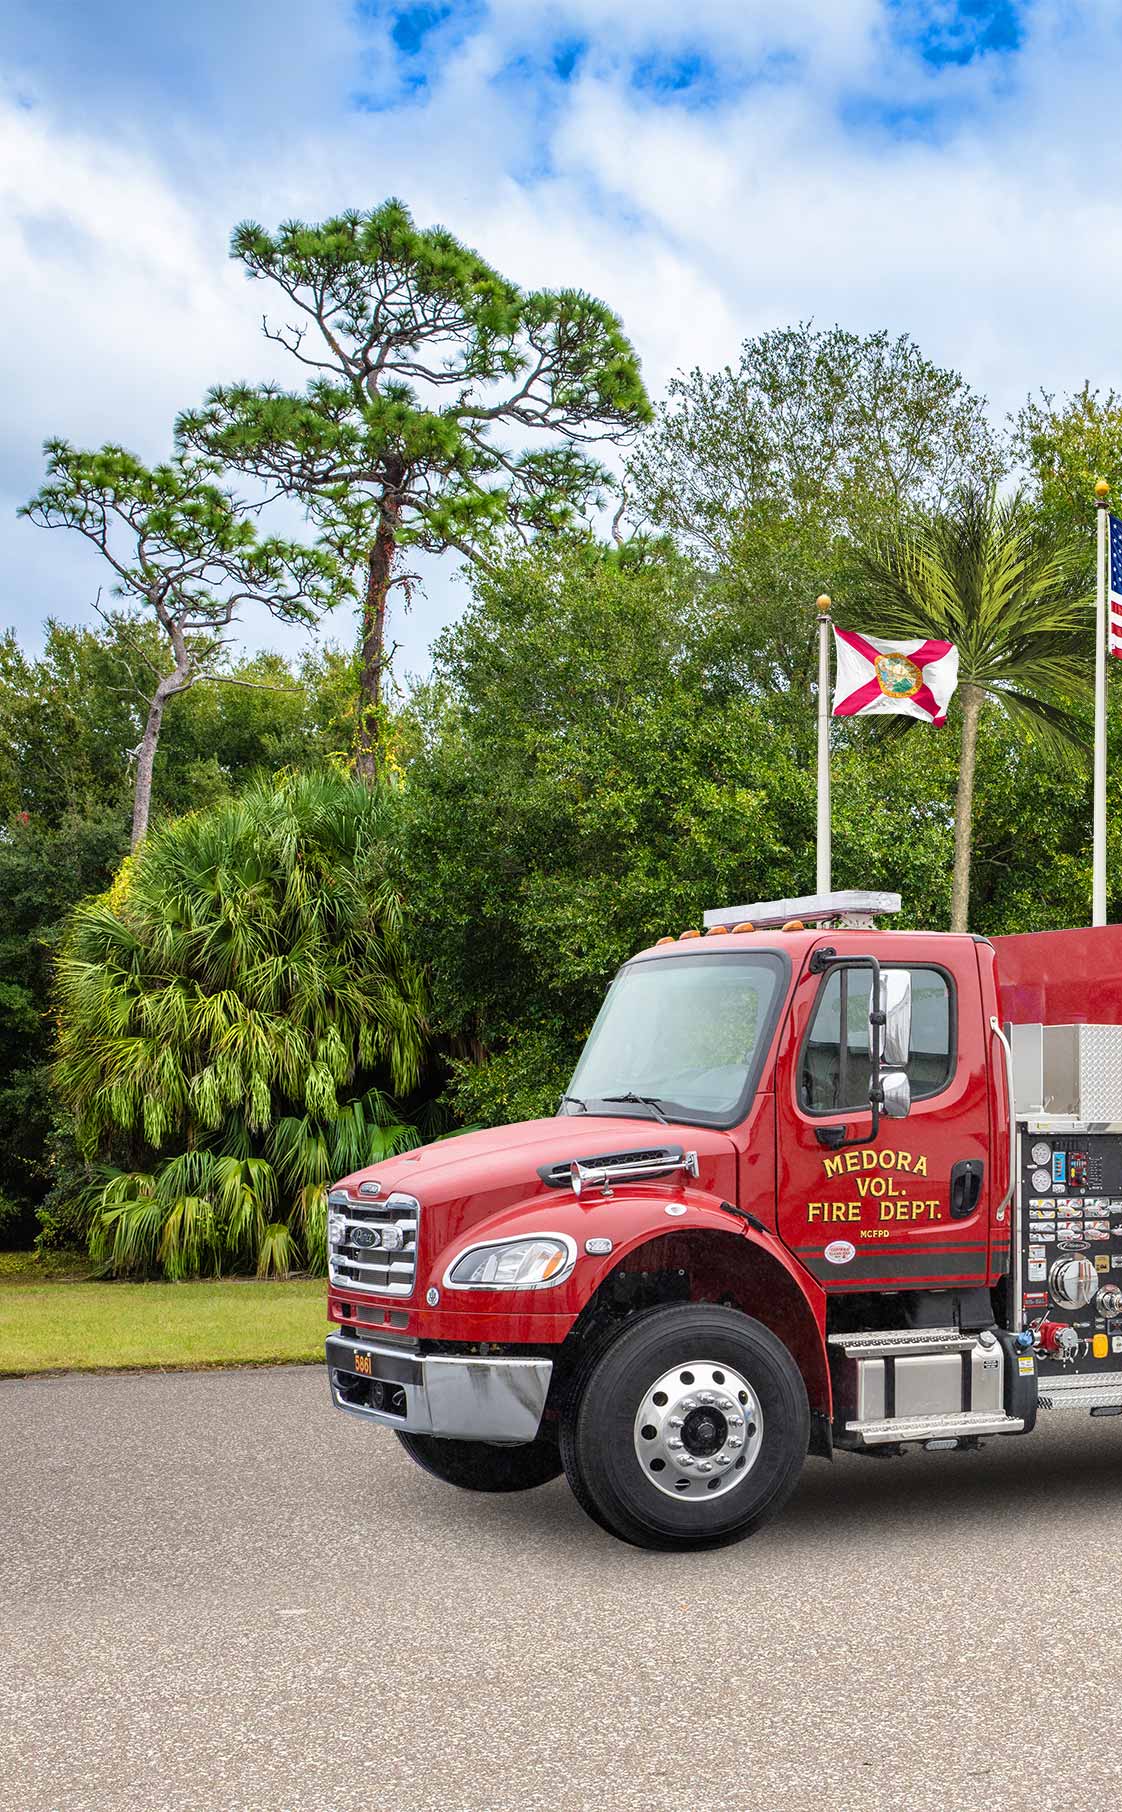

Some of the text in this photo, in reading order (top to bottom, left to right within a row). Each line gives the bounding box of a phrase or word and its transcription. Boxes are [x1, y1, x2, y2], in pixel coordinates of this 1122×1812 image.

[823, 1149, 928, 1179] MEDORA
[856, 1177, 907, 1197] VOL.
[807, 1200, 943, 1222] FIRE DEPT.
[860, 1230, 890, 1238] MCFPD
[354, 1354, 372, 1376] 5861
